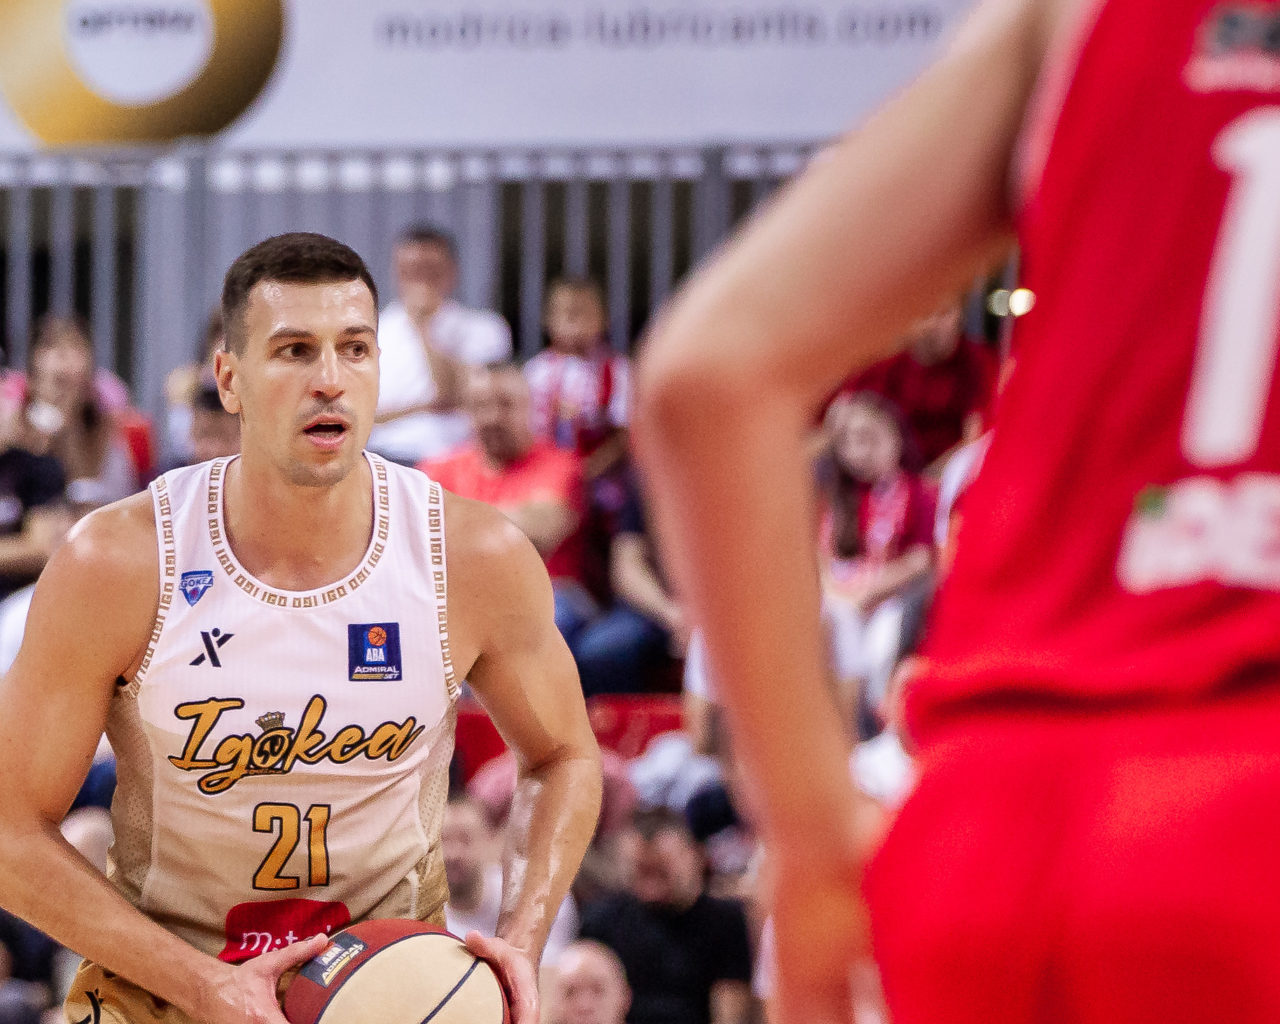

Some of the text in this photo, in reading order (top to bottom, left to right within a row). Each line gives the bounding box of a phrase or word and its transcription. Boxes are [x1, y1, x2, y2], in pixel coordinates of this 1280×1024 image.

[353, 665, 400, 674] ADMIRAL
[365, 647, 385, 662] ABA
[167, 693, 426, 796] Igokea
[251, 801, 332, 891] 21
